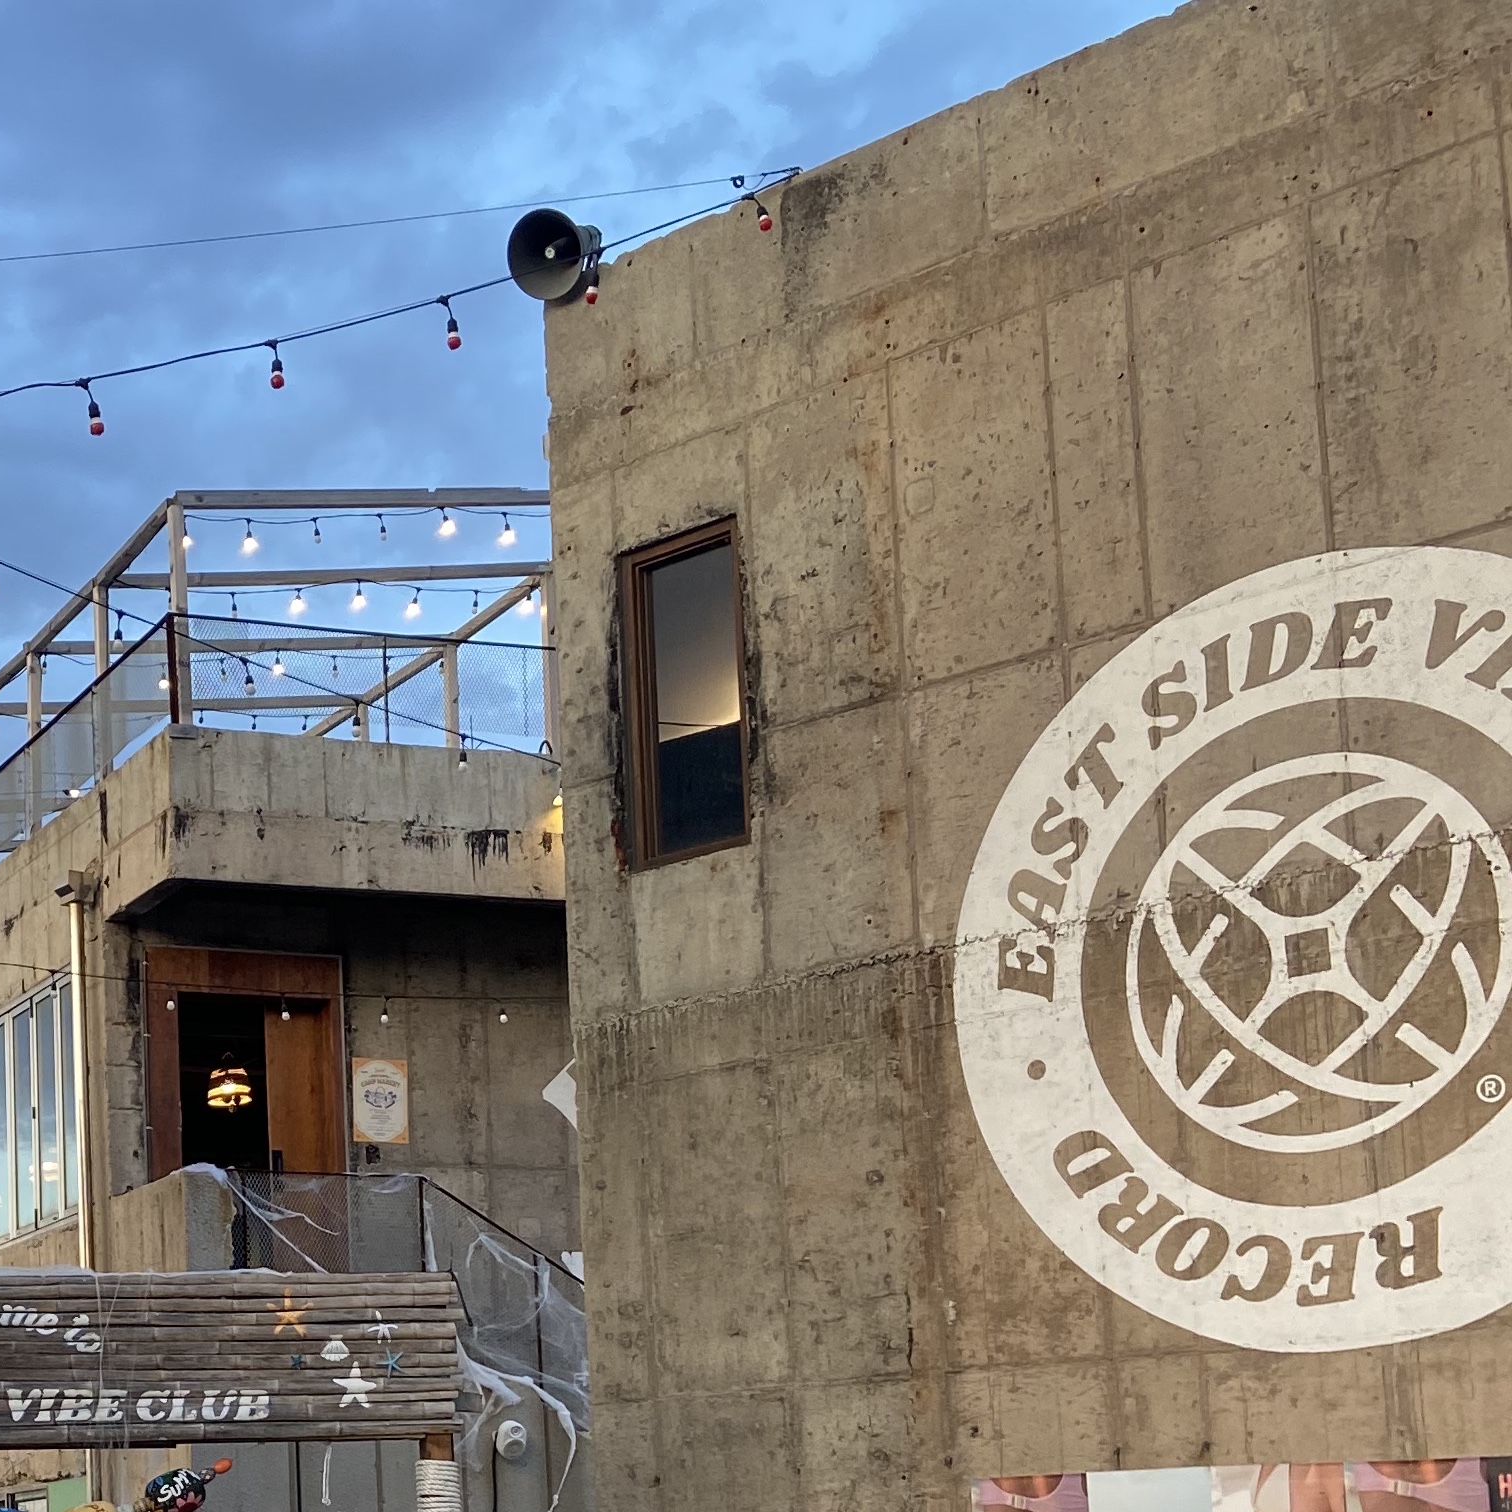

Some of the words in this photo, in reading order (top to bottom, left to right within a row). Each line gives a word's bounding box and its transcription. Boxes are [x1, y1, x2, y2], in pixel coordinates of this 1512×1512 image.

[997, 721, 1125, 1003] EAST
[1139, 596, 1394, 752] SIDE
[1425, 598, 1512, 702] VI
[1052, 1129, 1445, 1307] RECORD
[63, 1313, 102, 1353] to
[6, 1387, 129, 1422] VIBE
[136, 1388, 271, 1422] CLUB
